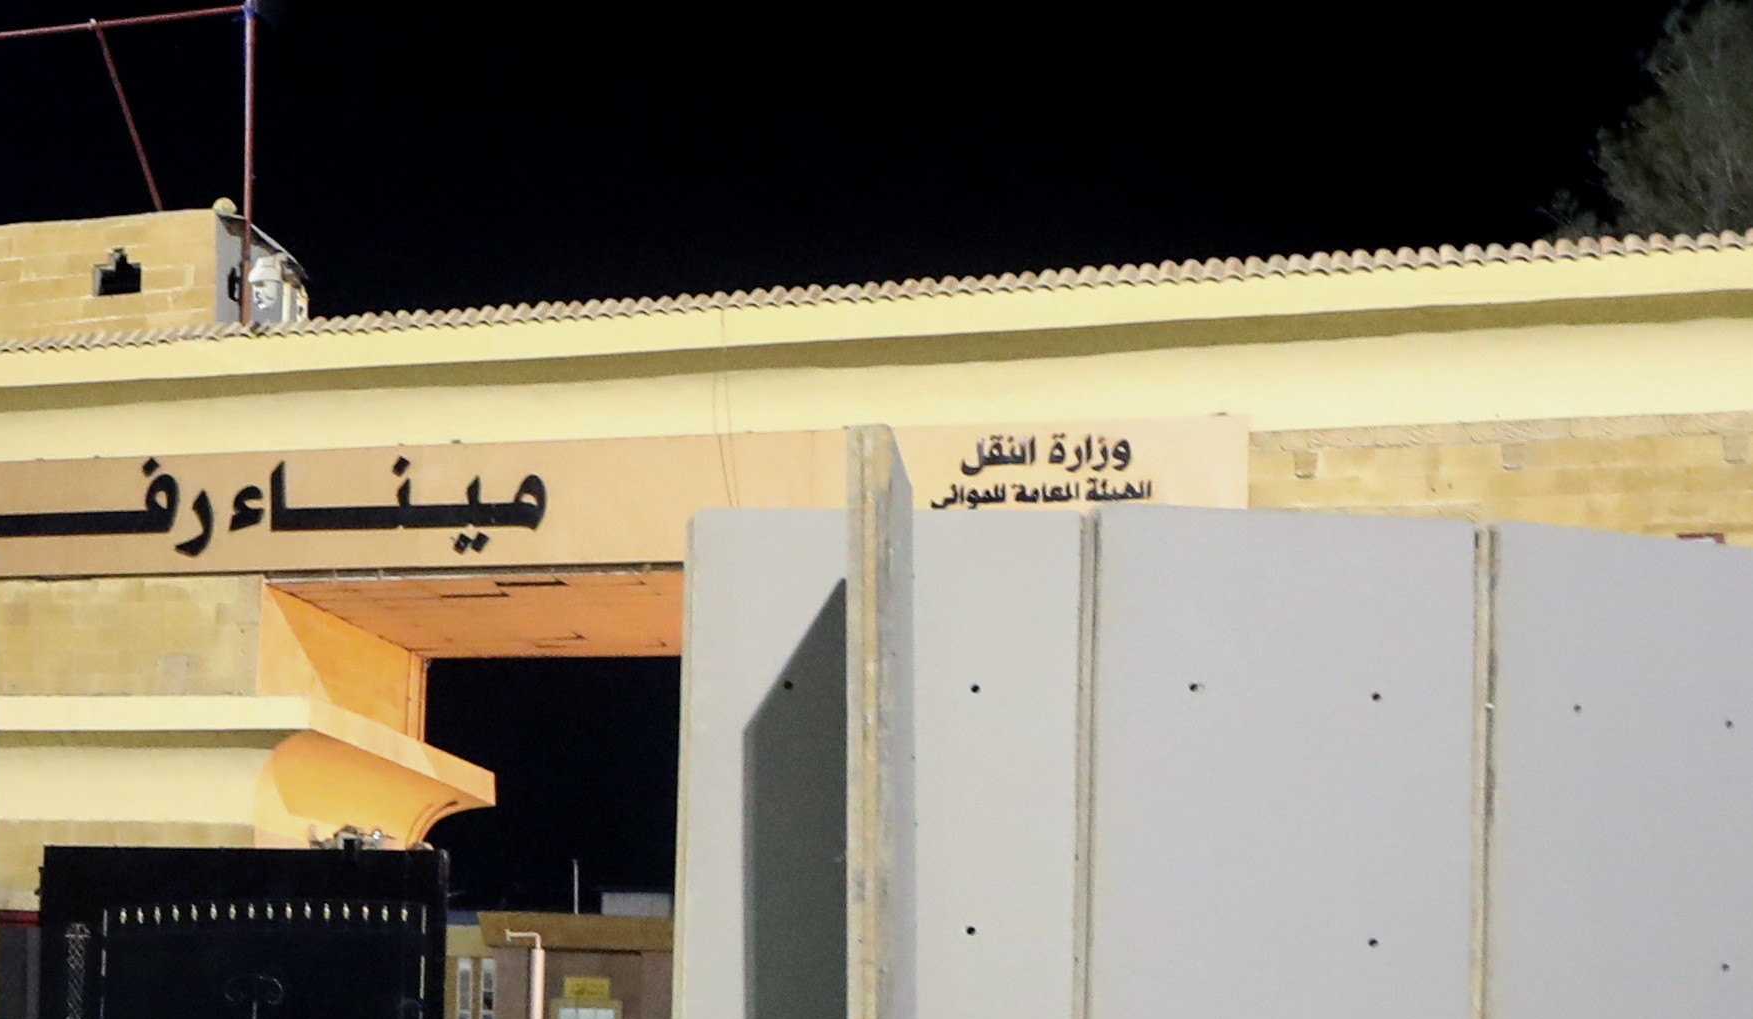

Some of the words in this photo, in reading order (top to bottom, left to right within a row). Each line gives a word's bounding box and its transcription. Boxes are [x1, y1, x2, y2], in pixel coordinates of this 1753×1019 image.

[961, 434, 1035, 475] النقل
[1048, 432, 1132, 472] وزارة
[230, 457, 546, 552] ميناء
[1011, 482, 1080, 503] العامة
